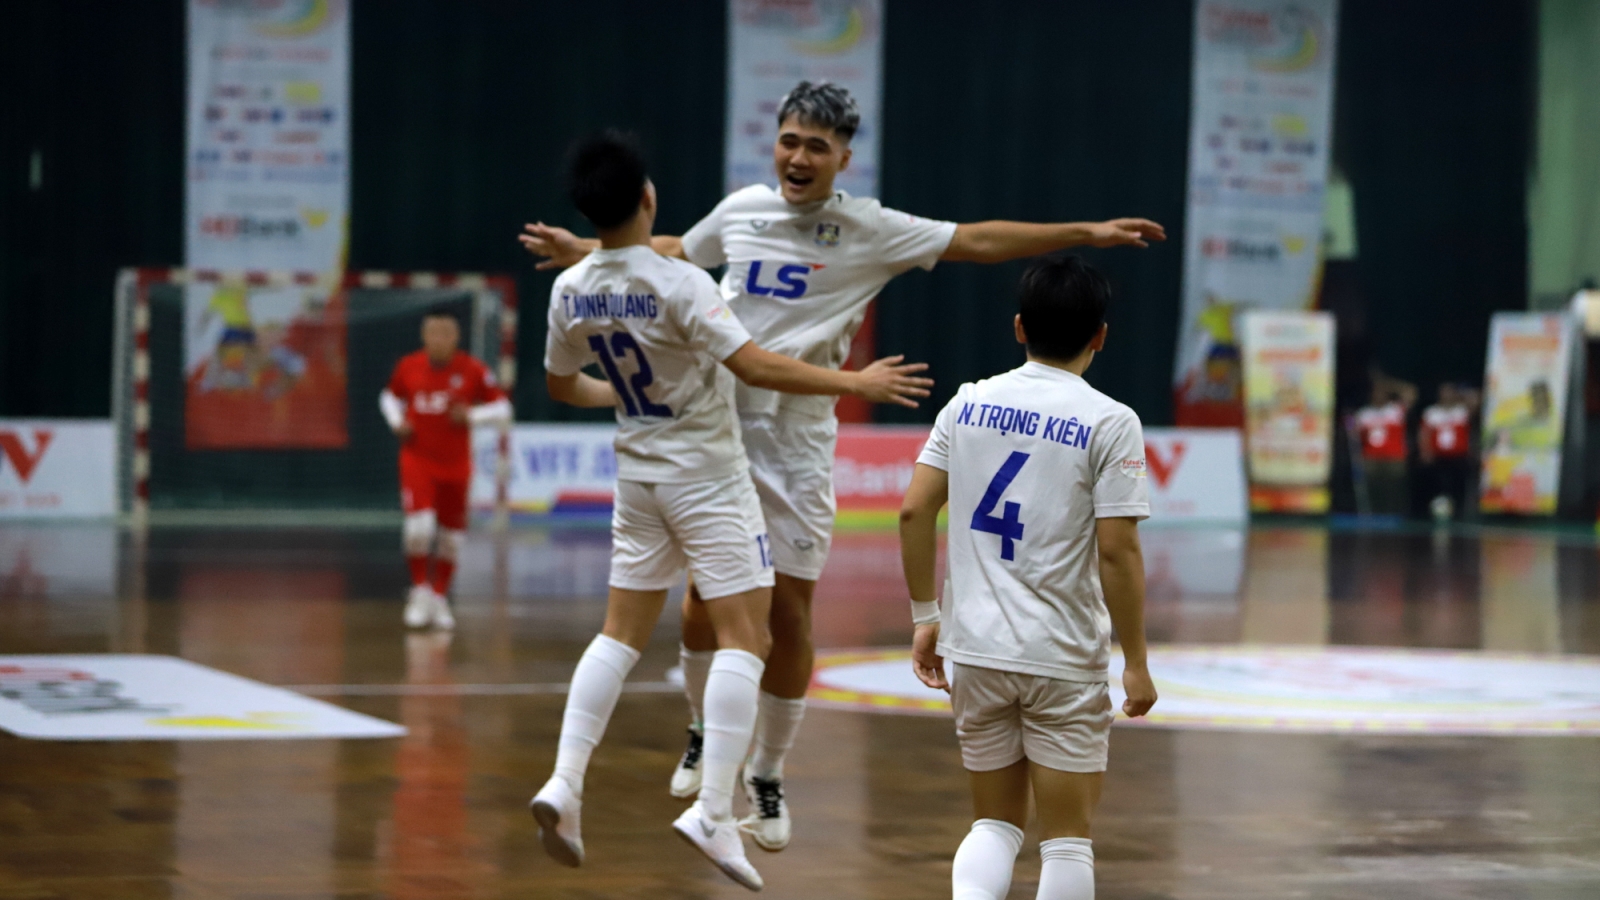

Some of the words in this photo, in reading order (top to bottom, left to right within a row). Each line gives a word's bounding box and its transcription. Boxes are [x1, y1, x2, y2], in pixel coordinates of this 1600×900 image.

[746, 260, 810, 299] LS
[587, 330, 674, 417] 12
[957, 403, 1040, 436] N.TRỌNG
[1042, 416, 1092, 450] KIÊN
[970, 450, 1031, 562] 4
